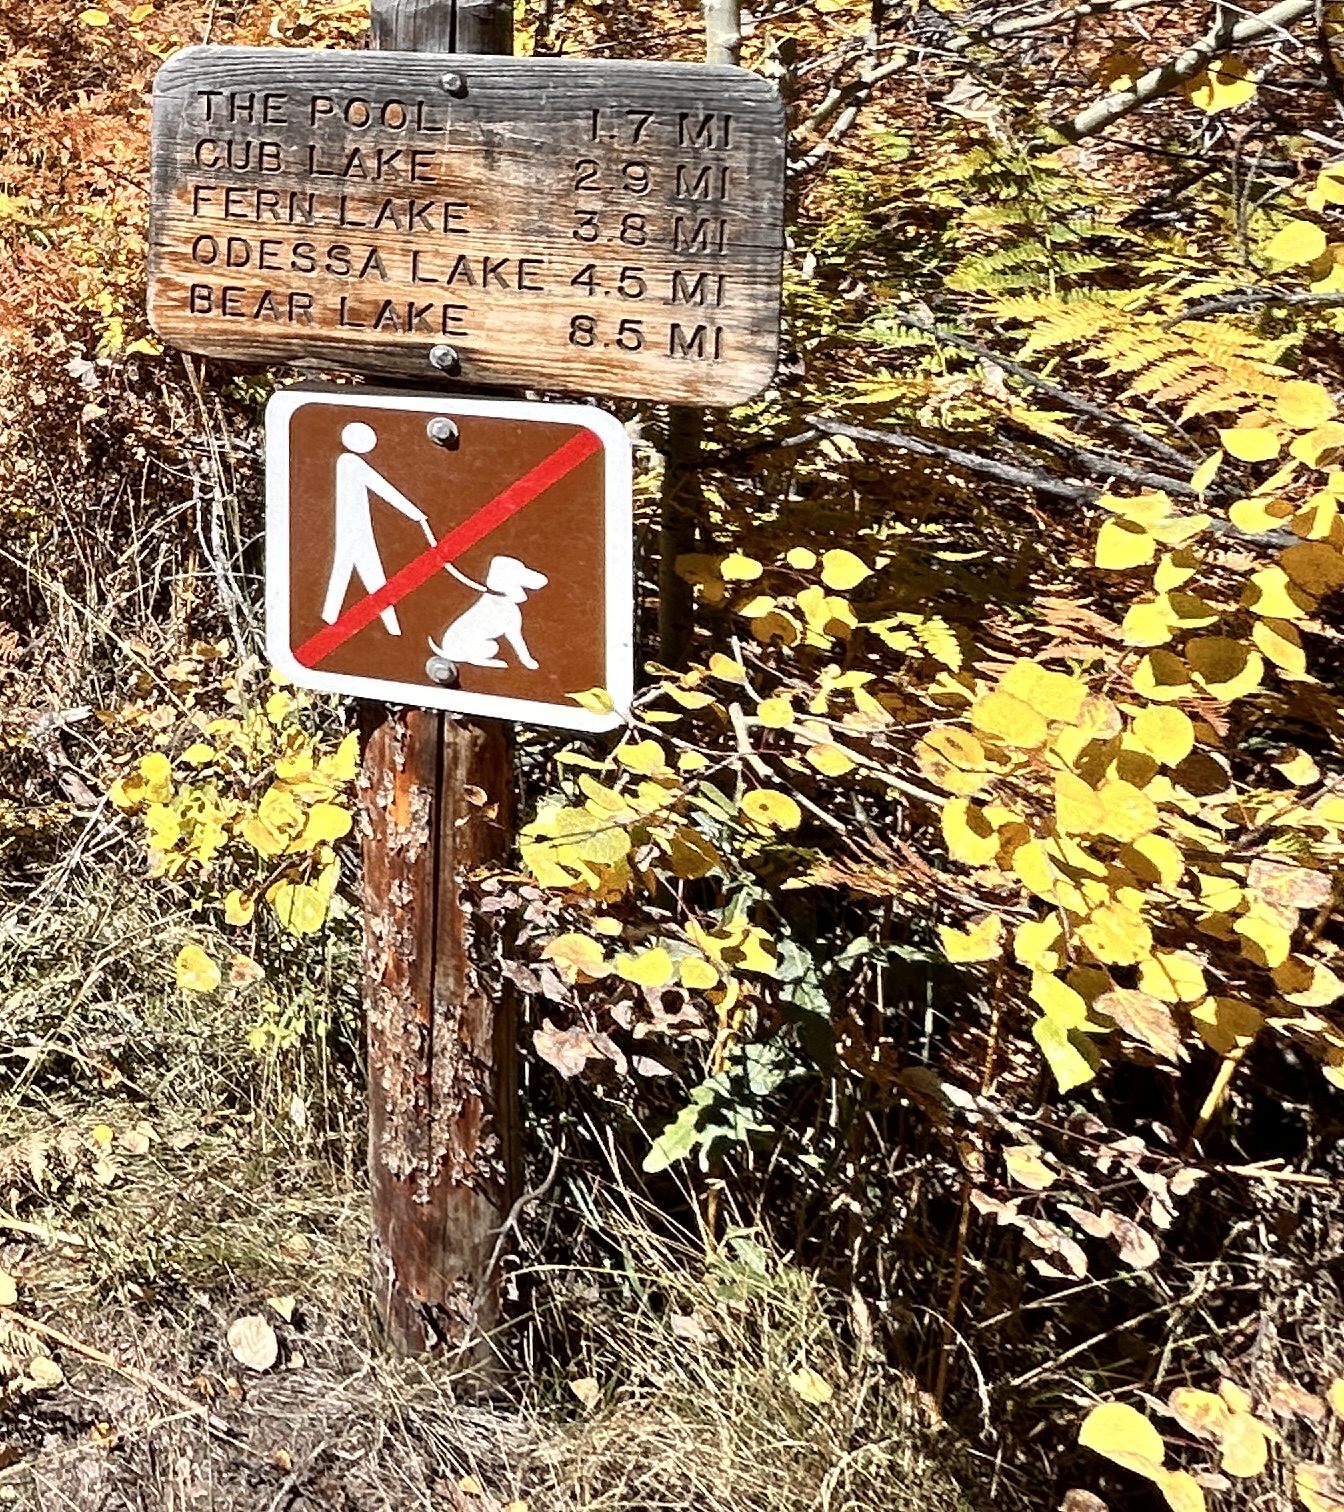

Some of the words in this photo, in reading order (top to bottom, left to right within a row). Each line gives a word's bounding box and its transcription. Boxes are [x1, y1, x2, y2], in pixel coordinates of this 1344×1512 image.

[197, 90, 288, 126] THE
[309, 95, 444, 134] POOL
[590, 108, 655, 143] 1.7
[677, 110, 732, 149] MI
[194, 139, 282, 174] CUB
[308, 145, 436, 183] LAKE
[573, 159, 650, 194] 2.9
[675, 161, 730, 200] MI
[191, 185, 314, 223] FERN
[339, 194, 470, 234] LAKE
[571, 209, 648, 247] 3.8
[673, 215, 729, 255] MI
[191, 235, 388, 282] ODESSA
[411, 250, 544, 292] LAKE
[569, 263, 648, 300] 4.5
[670, 269, 726, 308] MI
[189, 284, 314, 323] BEAR
[339, 294, 470, 337] LAKE
[568, 314, 644, 352] 8.5
[669, 323, 723, 362] MI
